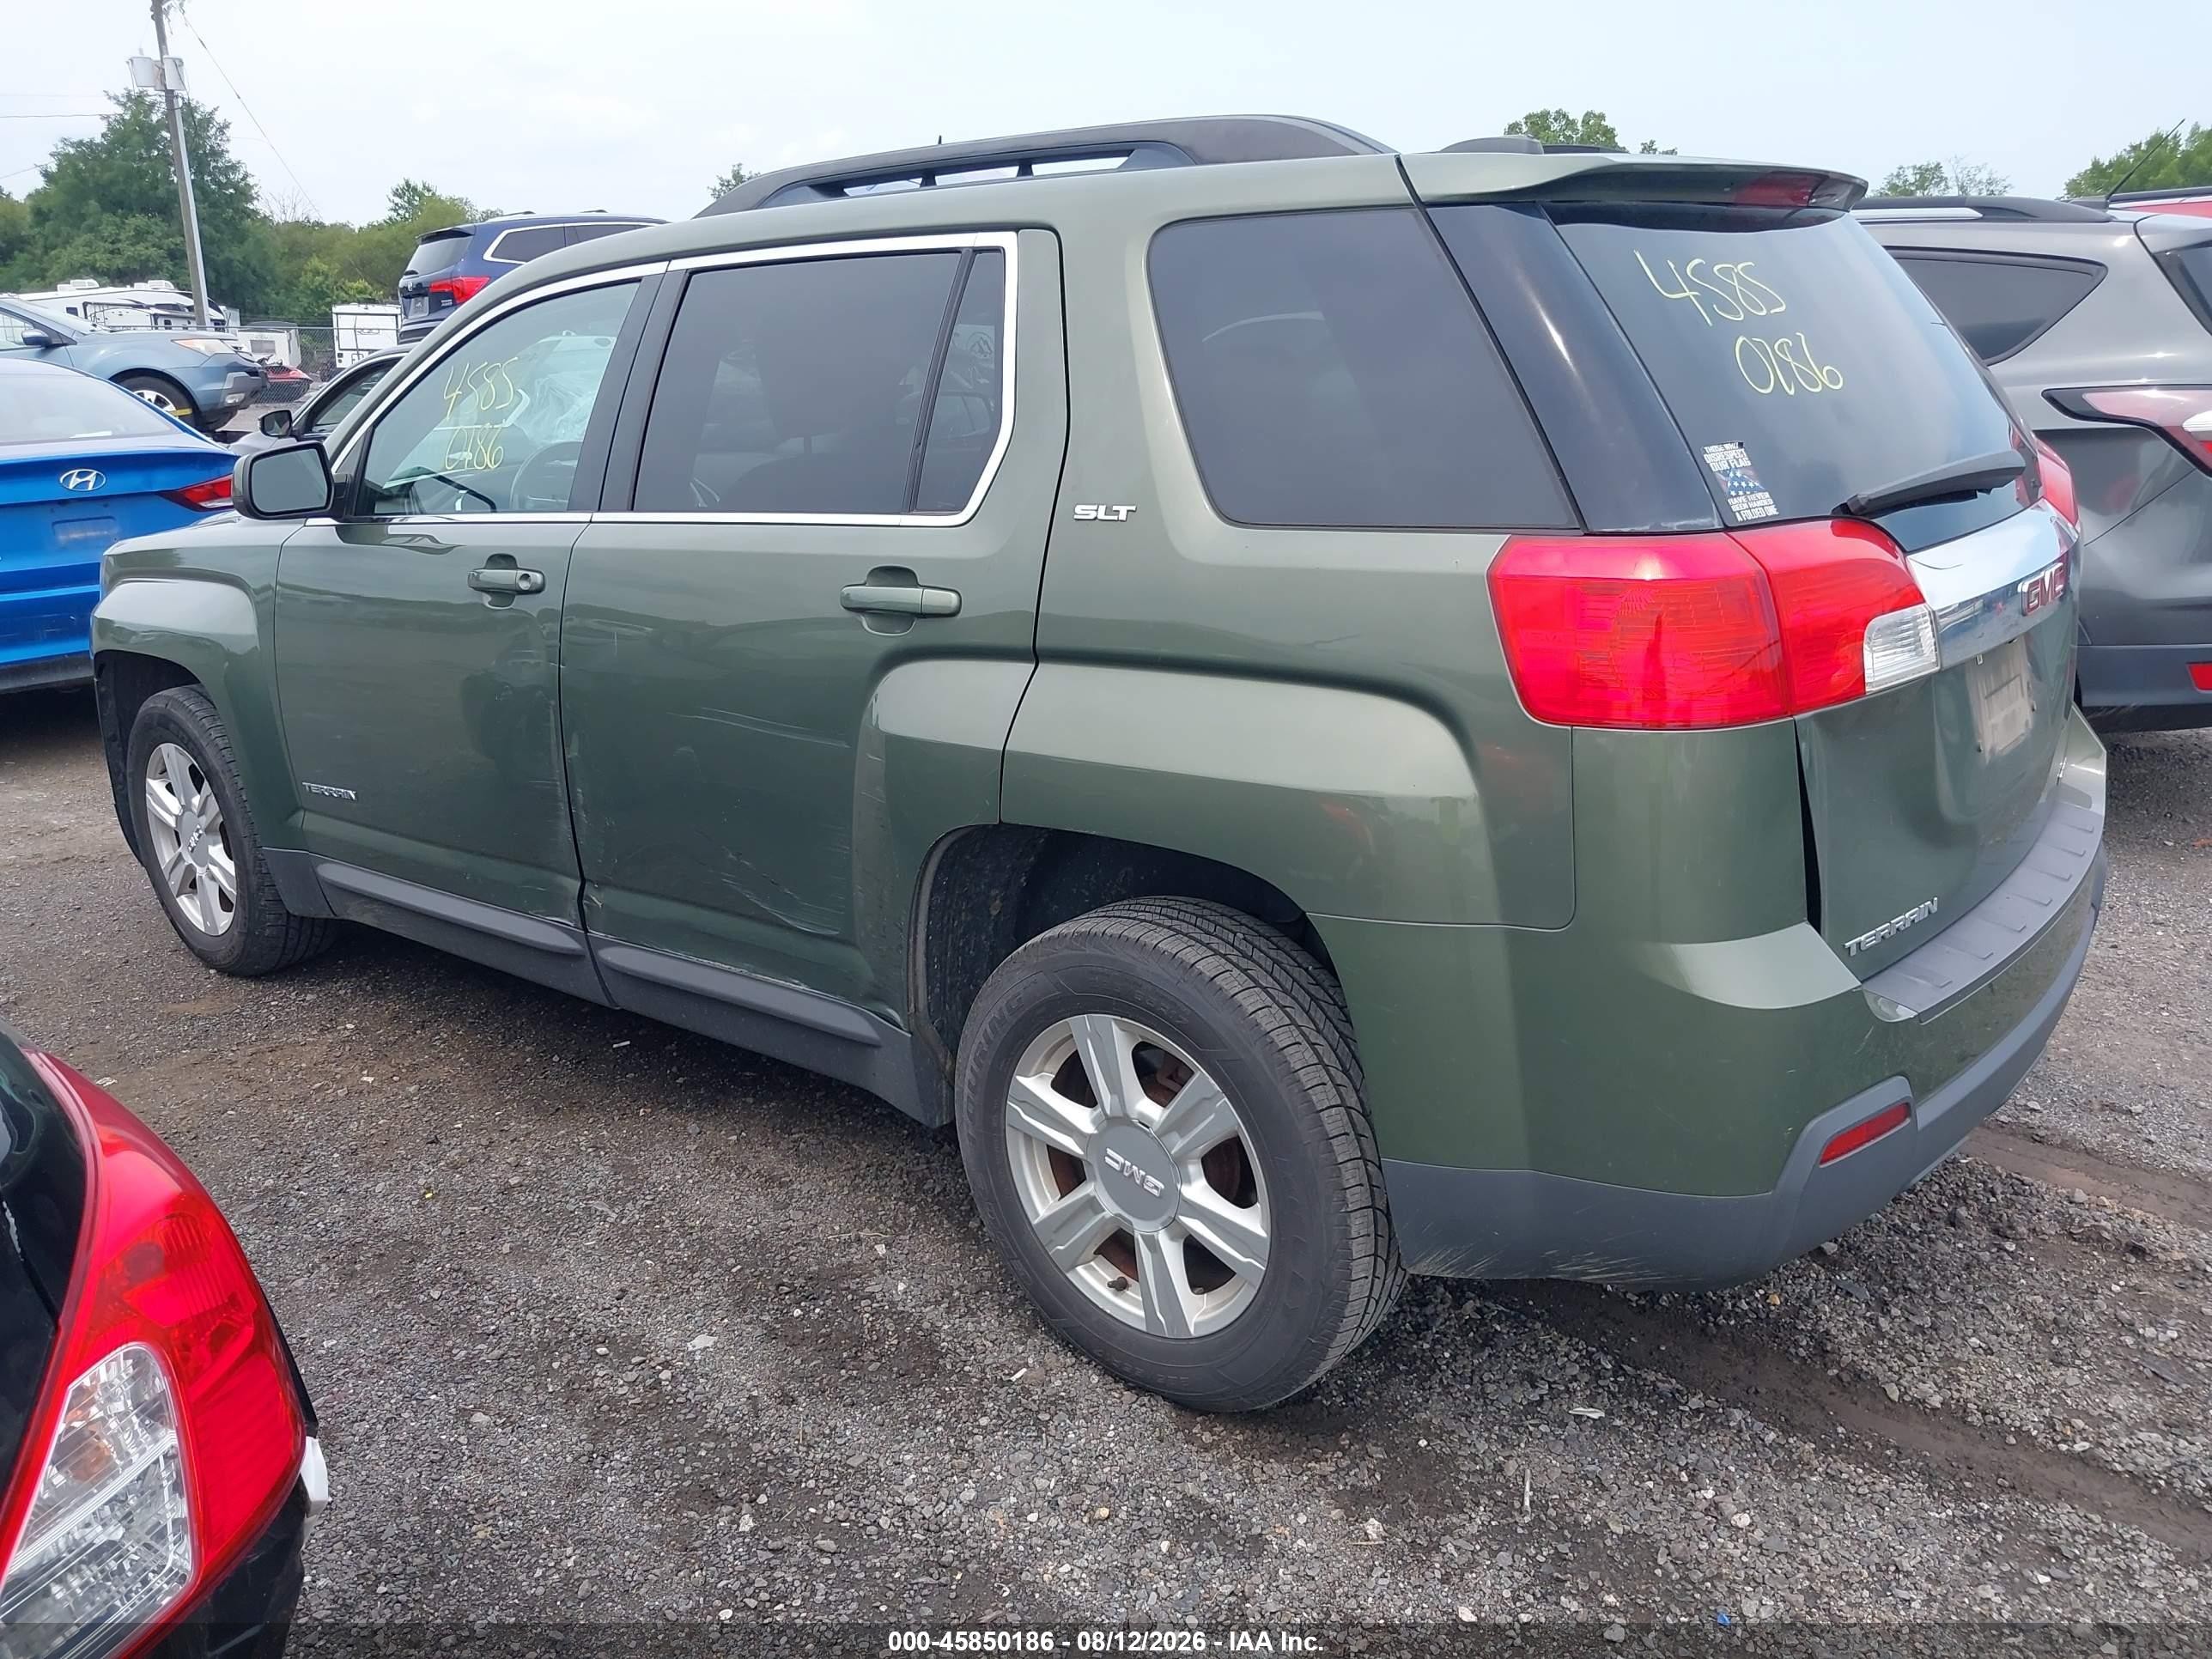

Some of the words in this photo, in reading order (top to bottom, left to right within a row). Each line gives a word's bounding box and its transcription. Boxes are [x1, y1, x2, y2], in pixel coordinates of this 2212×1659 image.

[1634, 249, 1787, 326] 4585
[1735, 332, 1844, 395] 0186
[443, 356, 519, 421] 4585
[446, 422, 504, 470] 0186
[1704, 444, 1724, 453] THOSE
[1704, 448, 1747, 464] DISRESPECT
[1710, 460, 1729, 472] OUR
[1729, 457, 1752, 468] FLAG
[1728, 495, 1747, 505] HAVE
[1747, 492, 1771, 501] NEVER
[1730, 502, 1749, 512] BEEN
[1747, 498, 1774, 508] HANDED
[1073, 504, 1138, 521] SLT
[1735, 511, 1743, 522] A
[1740, 507, 1766, 520] FOLDED
[1764, 504, 1779, 516] ONE
[2018, 562, 2064, 617] GMC
[302, 781, 357, 801] TERRAIN
[1844, 896, 1938, 957] TERRAIN
[1104, 1147, 1165, 1198] GMC
